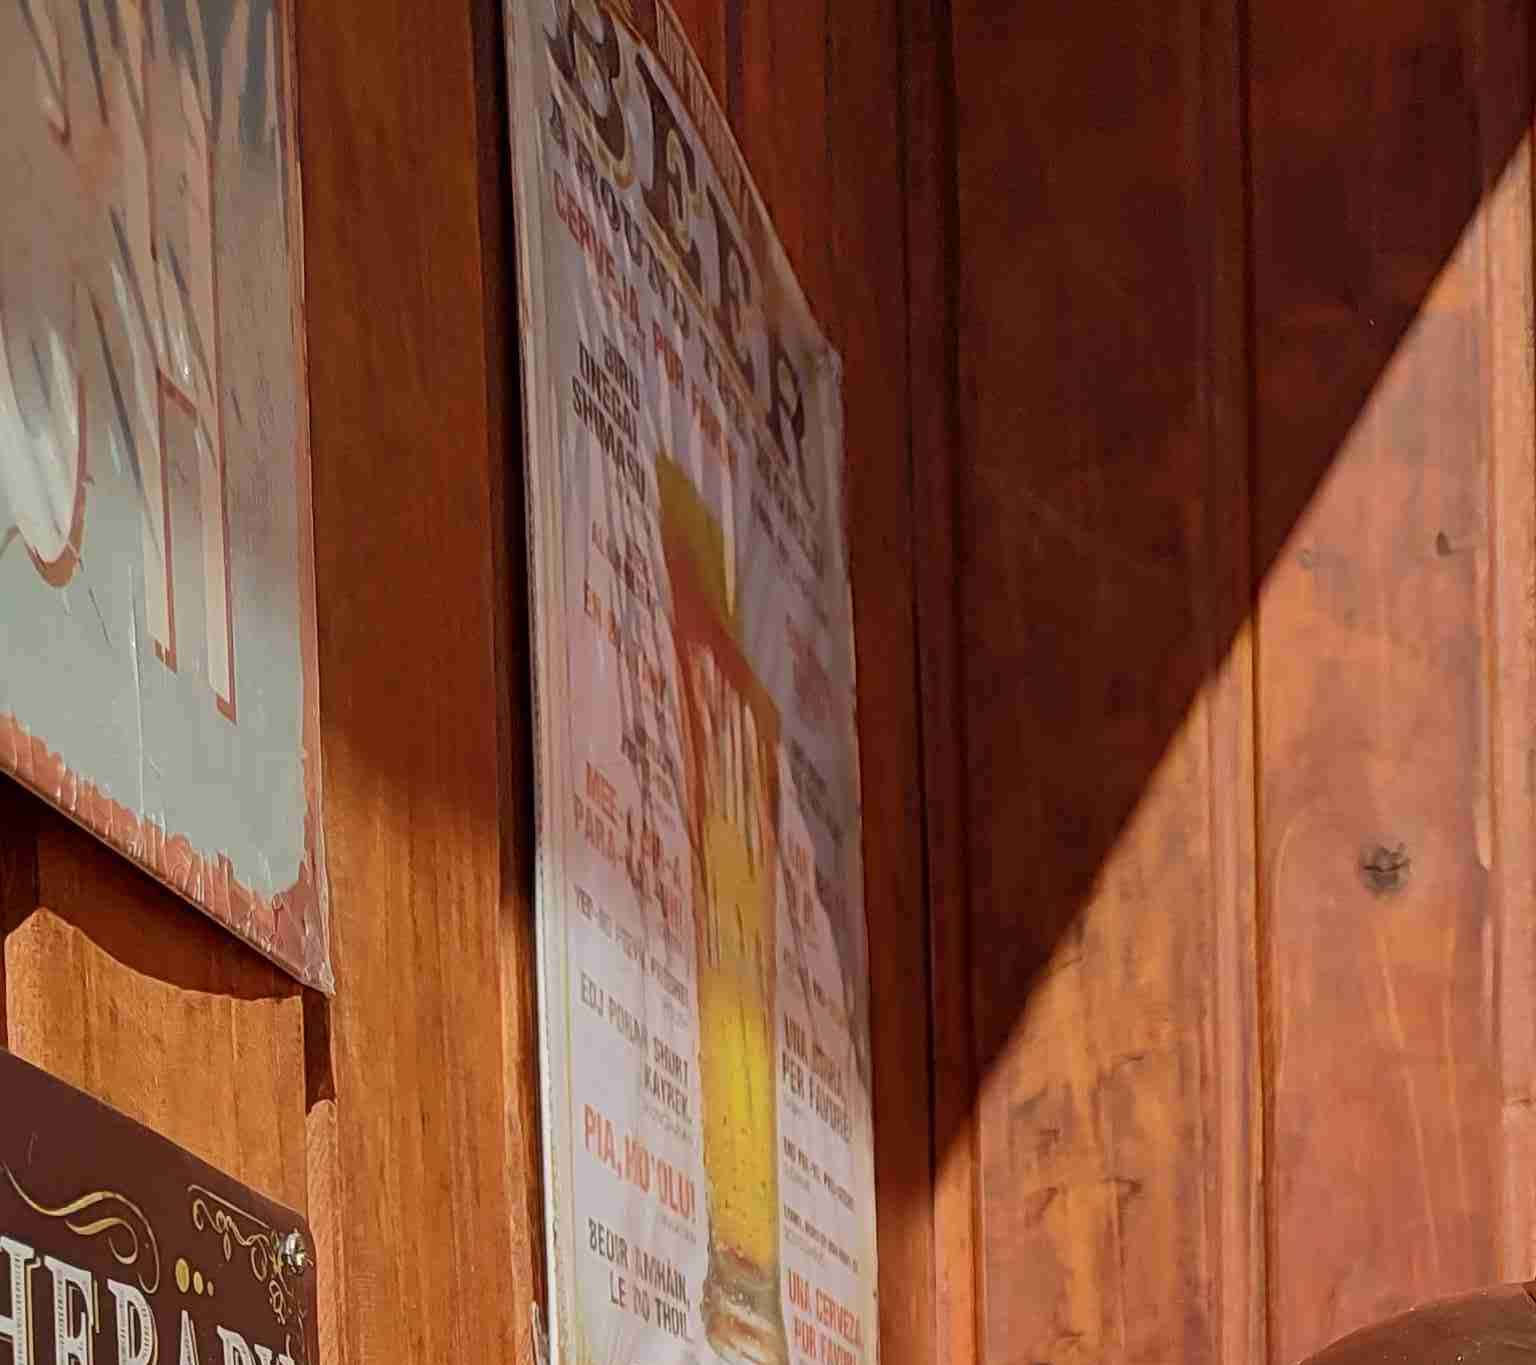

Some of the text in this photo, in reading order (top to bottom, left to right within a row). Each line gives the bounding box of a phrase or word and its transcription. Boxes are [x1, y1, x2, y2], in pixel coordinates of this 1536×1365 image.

[544, 0, 816, 512] BEER
[550, 95, 688, 338] AROUND
[572, 375, 645, 503] SHIMASU
[579, 340, 638, 452] ONEGAI
[609, 1268, 625, 1308] LE
[794, 1315, 816, 1361] POR
